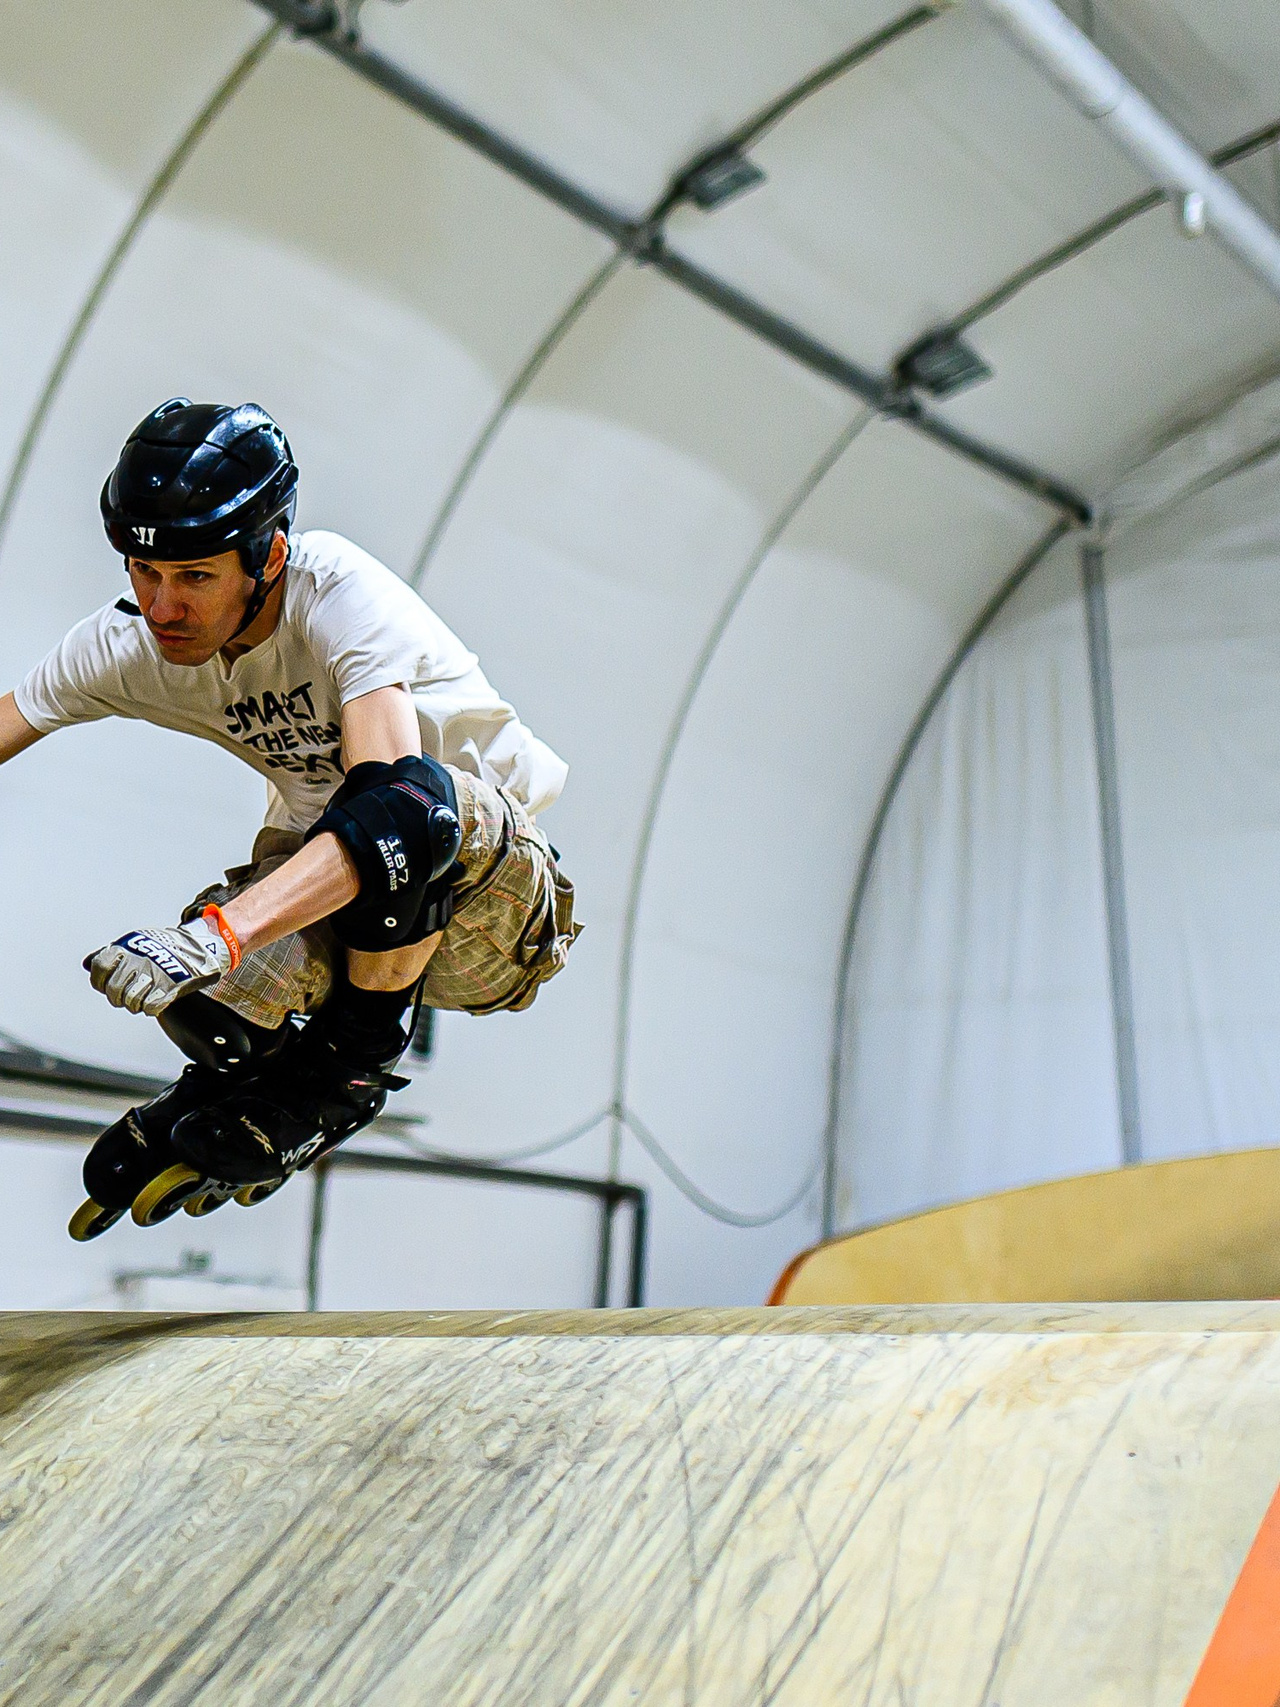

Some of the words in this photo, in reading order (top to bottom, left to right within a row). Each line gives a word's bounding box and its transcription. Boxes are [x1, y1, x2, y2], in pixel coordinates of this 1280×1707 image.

[224, 681, 316, 735] SMART
[243, 727, 300, 753] THE
[376, 838, 394, 870] KILLER
[386, 837, 410, 884] 187
[127, 935, 190, 978] LEATT
